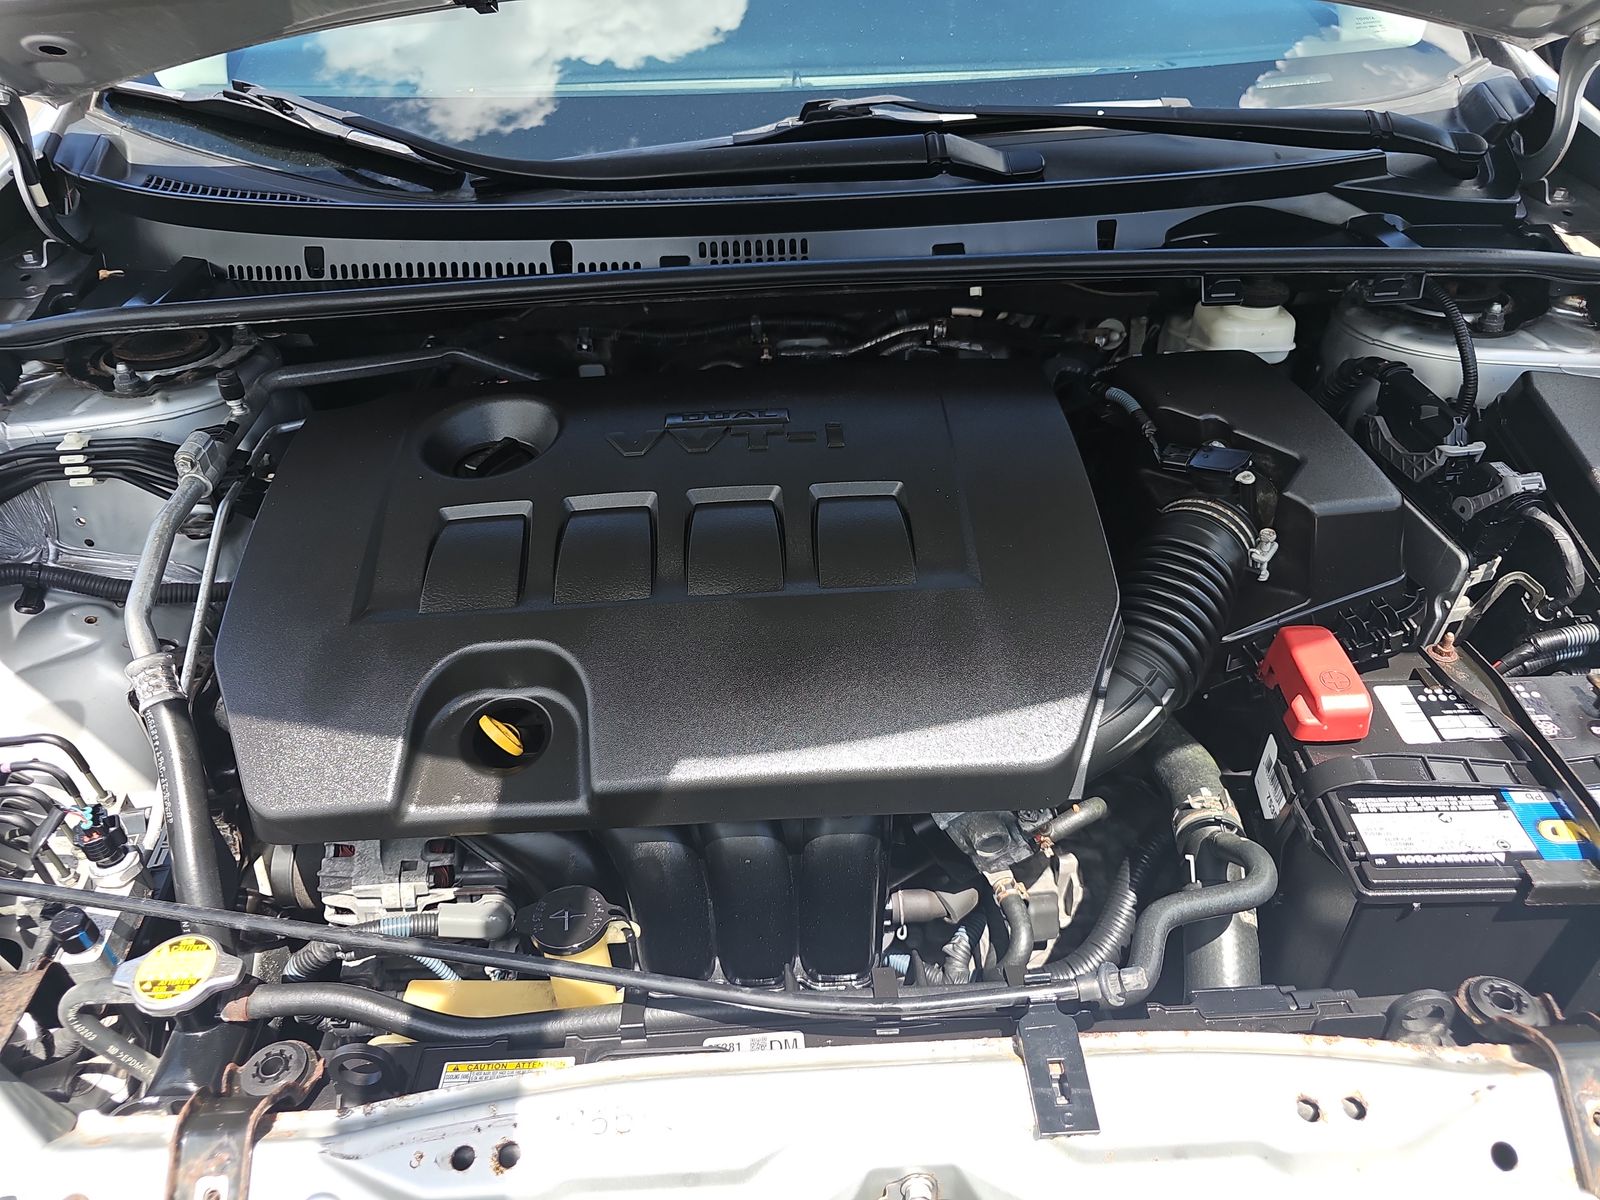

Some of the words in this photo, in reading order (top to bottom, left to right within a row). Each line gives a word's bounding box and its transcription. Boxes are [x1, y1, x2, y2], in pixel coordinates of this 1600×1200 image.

[681, 408, 778, 422] DUAL
[1525, 792, 1543, 801] Pb
[769, 1037, 798, 1051] DM
[466, 1063, 508, 1071] CAUTION
